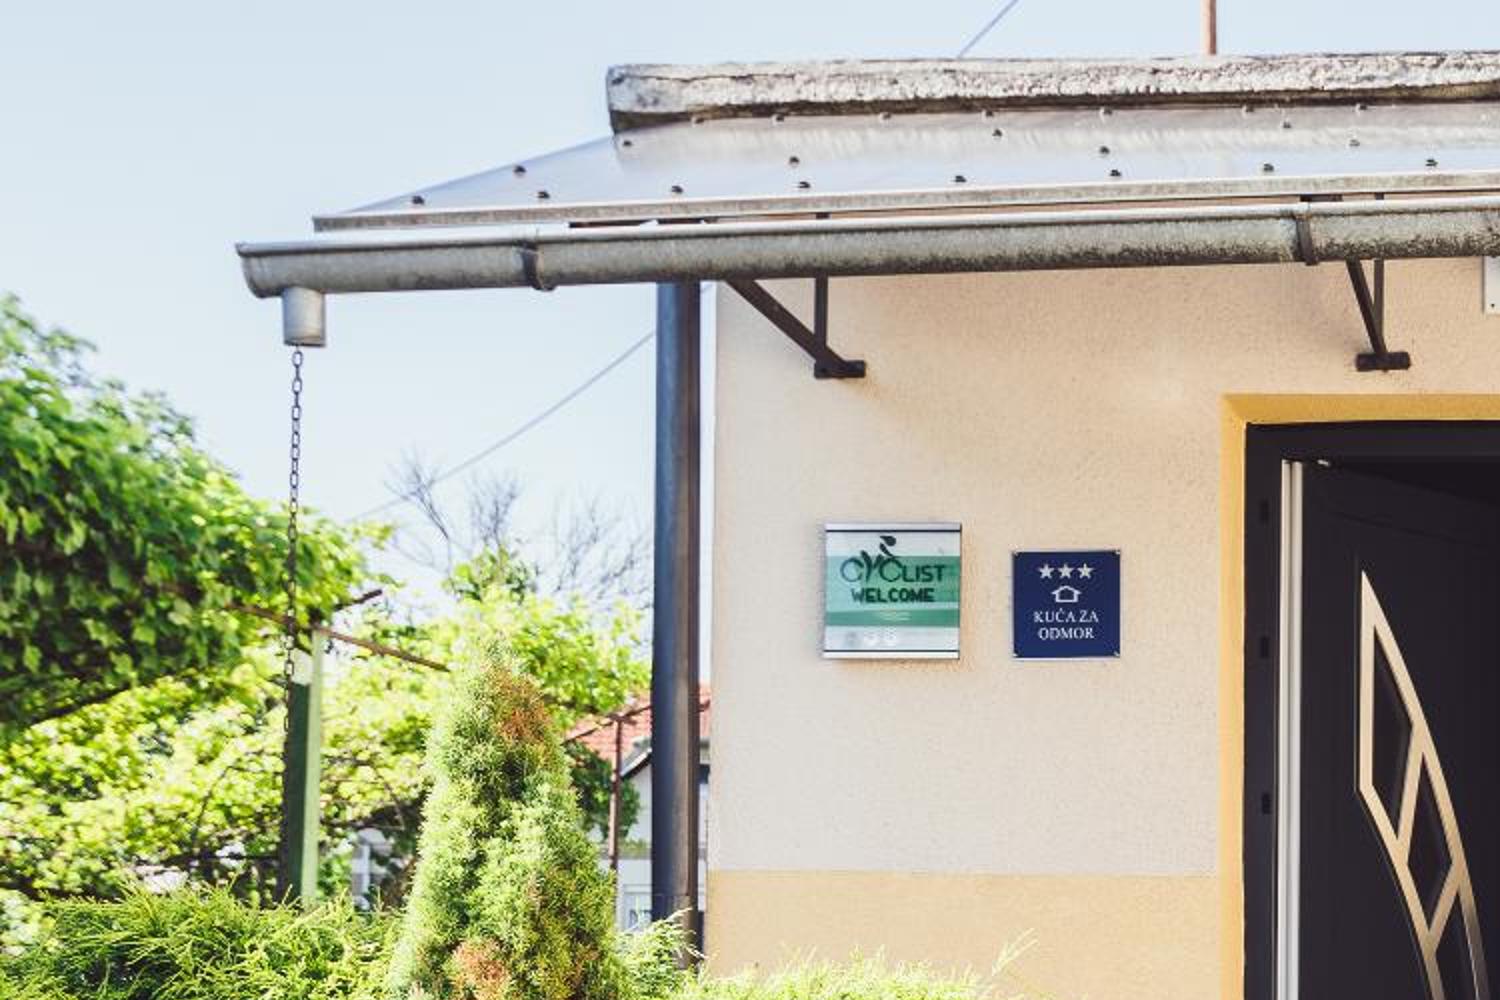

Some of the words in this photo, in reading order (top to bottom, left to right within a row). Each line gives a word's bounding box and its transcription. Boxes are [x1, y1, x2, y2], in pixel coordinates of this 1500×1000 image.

[840, 550, 946, 583] CYCLIST
[851, 587, 935, 604] WELCOME
[1078, 610, 1099, 623] ZA
[1037, 627, 1095, 640] ODMOR
